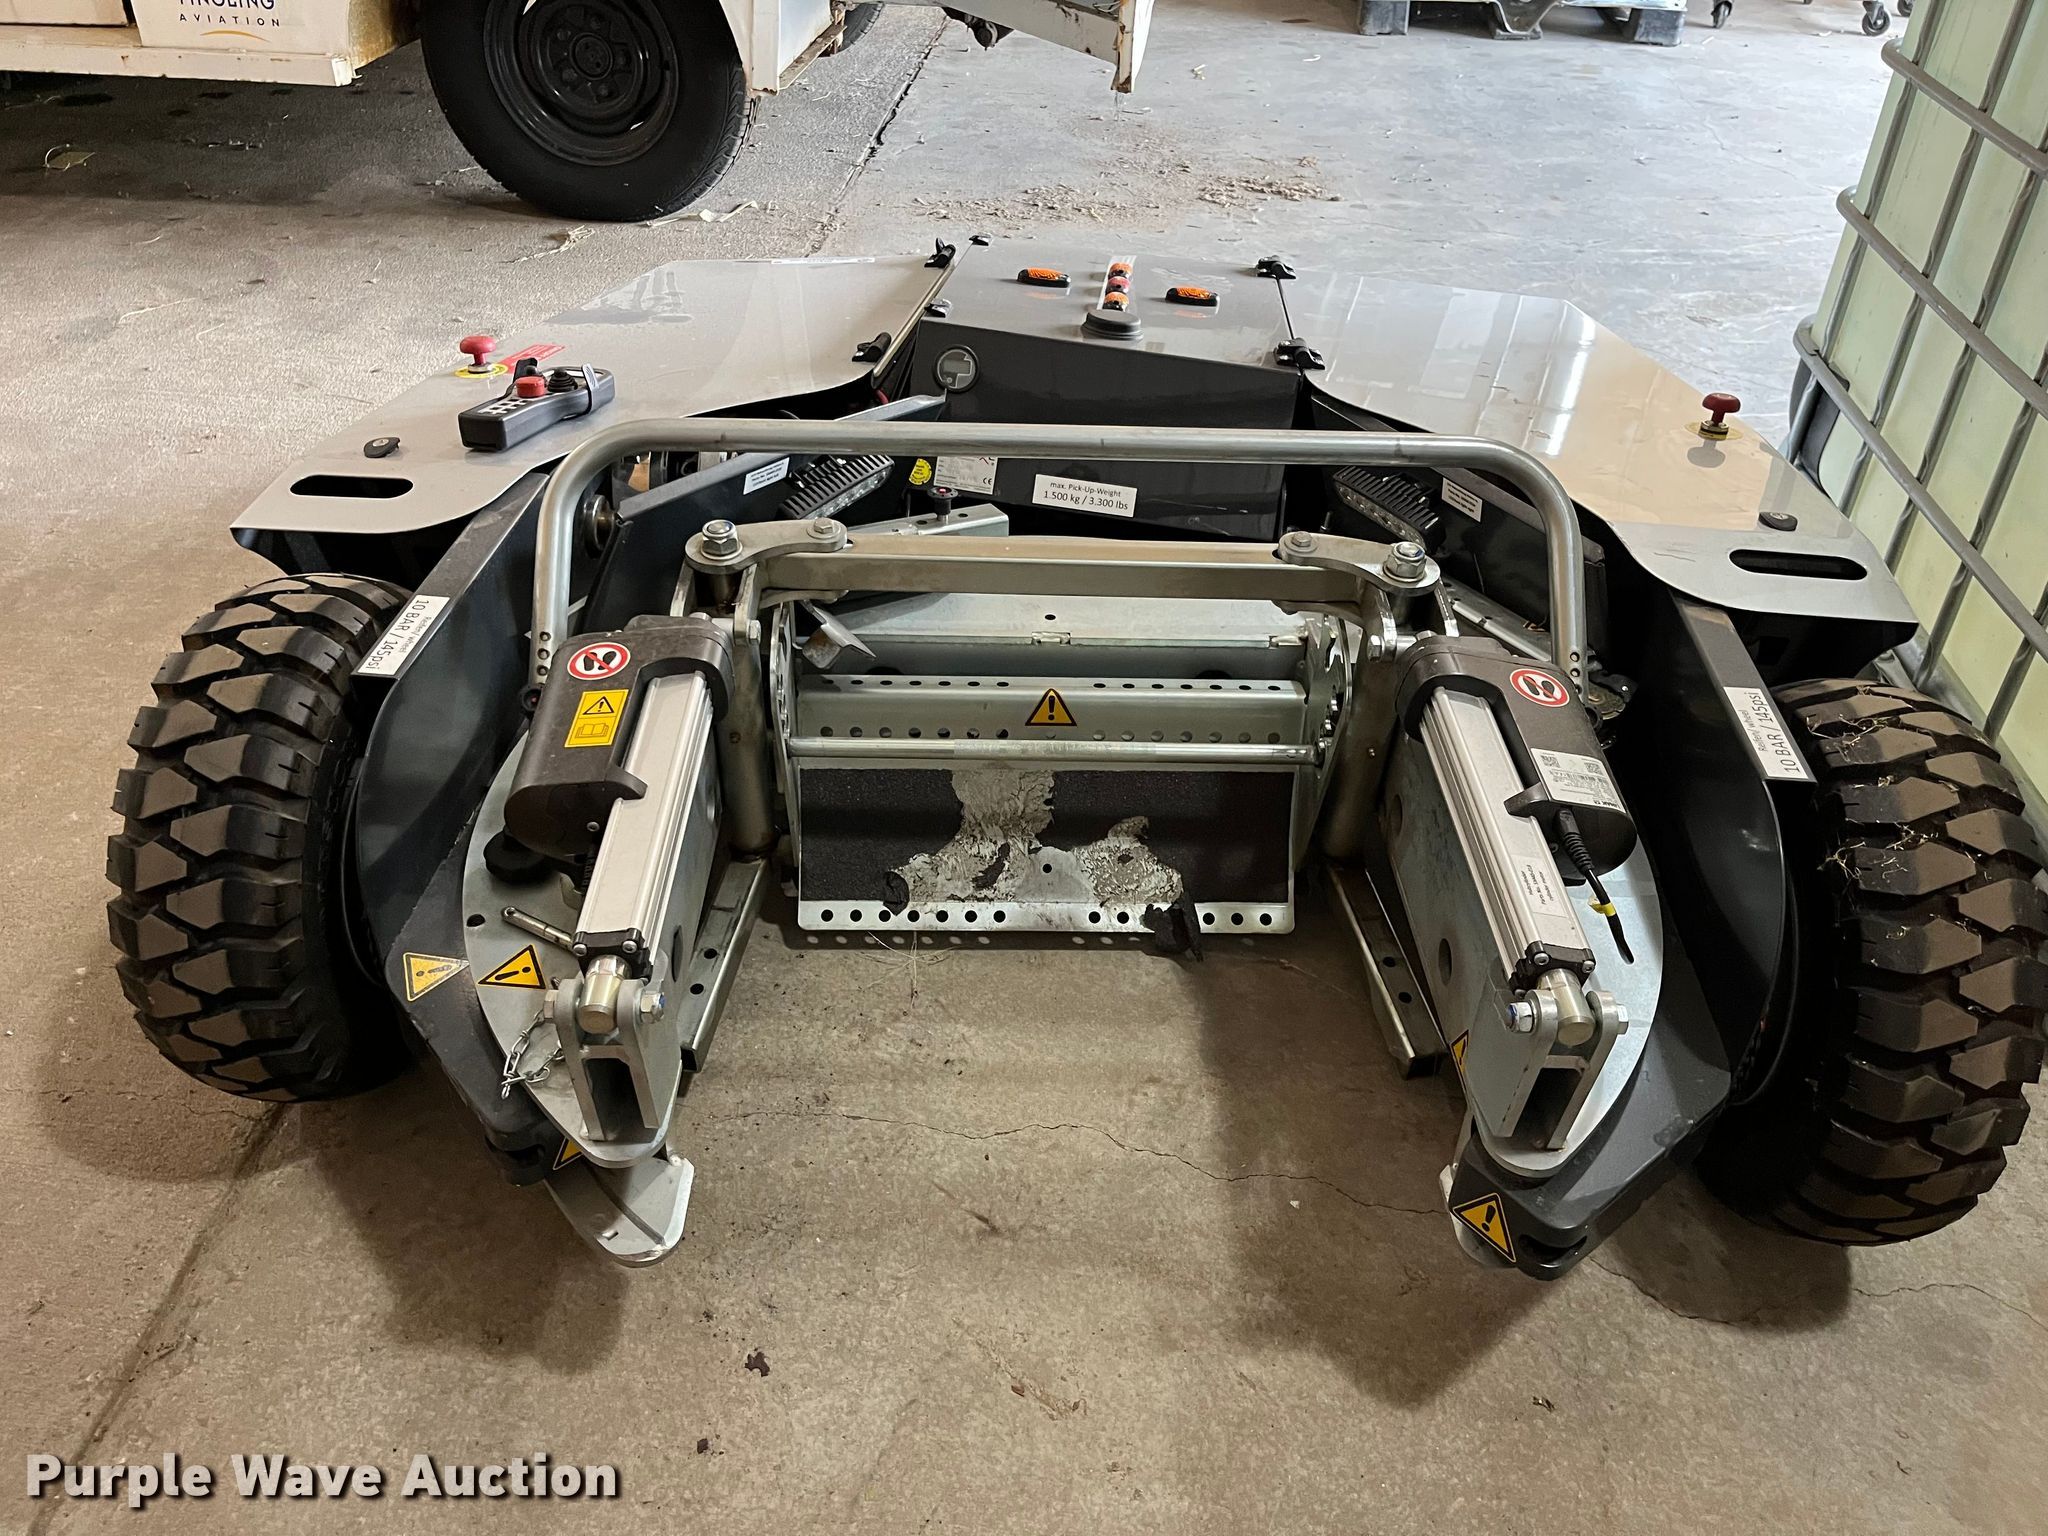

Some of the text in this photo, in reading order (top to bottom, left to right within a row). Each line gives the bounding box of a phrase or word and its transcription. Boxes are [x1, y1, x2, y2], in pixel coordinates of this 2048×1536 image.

[180, 13, 280, 27] AVIATION
[1050, 481, 1121, 498] max. Pick-Up-Weight
[1044, 490, 1128, 510] 1.500 kg / 3.300 lbs
[411, 600, 430, 611] 10
[394, 611, 420, 631] BAR
[365, 640, 398, 669] 145psi
[1744, 691, 1774, 723] 145psi
[1767, 734, 1791, 756] BAR
[1780, 759, 1800, 773] 10
